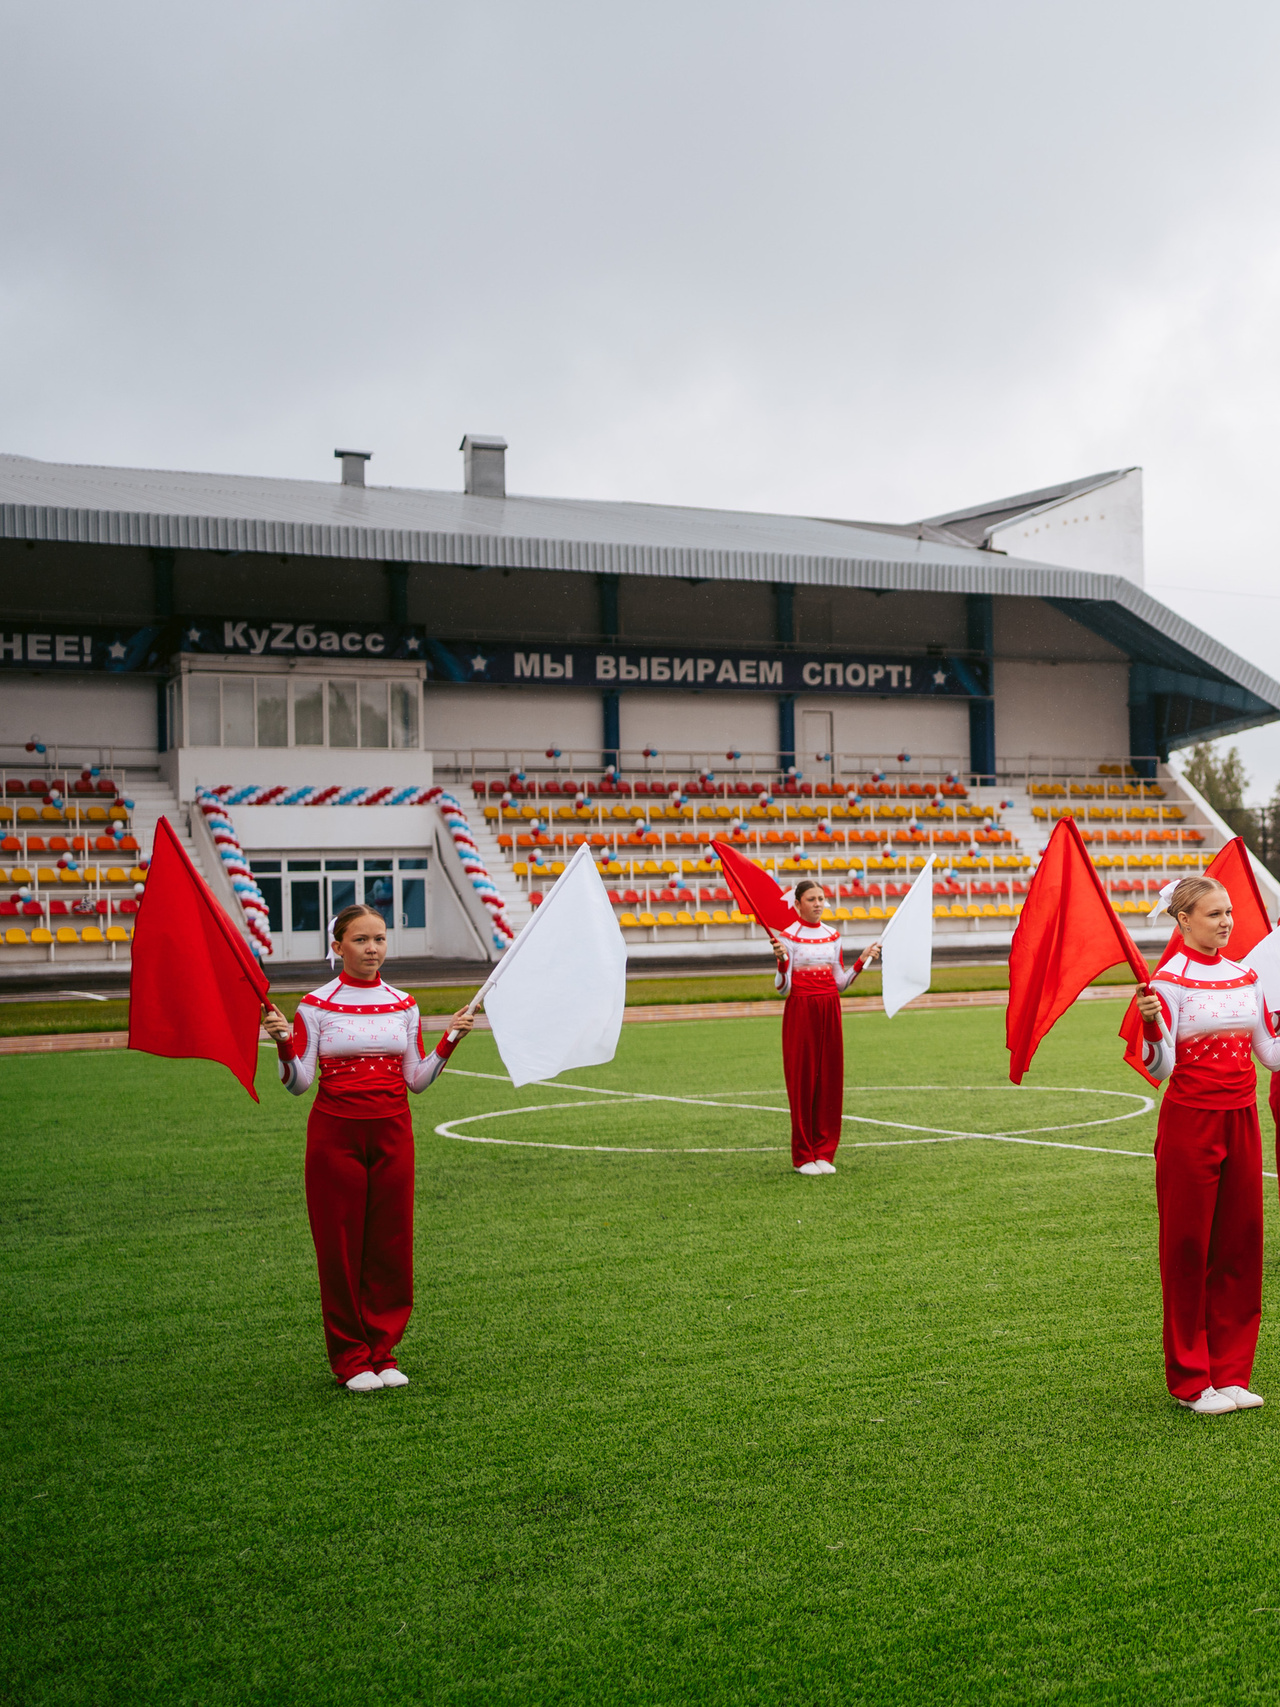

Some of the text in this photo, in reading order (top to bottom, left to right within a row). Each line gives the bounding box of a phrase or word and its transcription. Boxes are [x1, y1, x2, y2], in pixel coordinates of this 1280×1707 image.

[224, 621, 386, 655] КуZбасс
[513, 653, 912, 688] МЫ ВЫБИРАЕМ СПОРТ!
